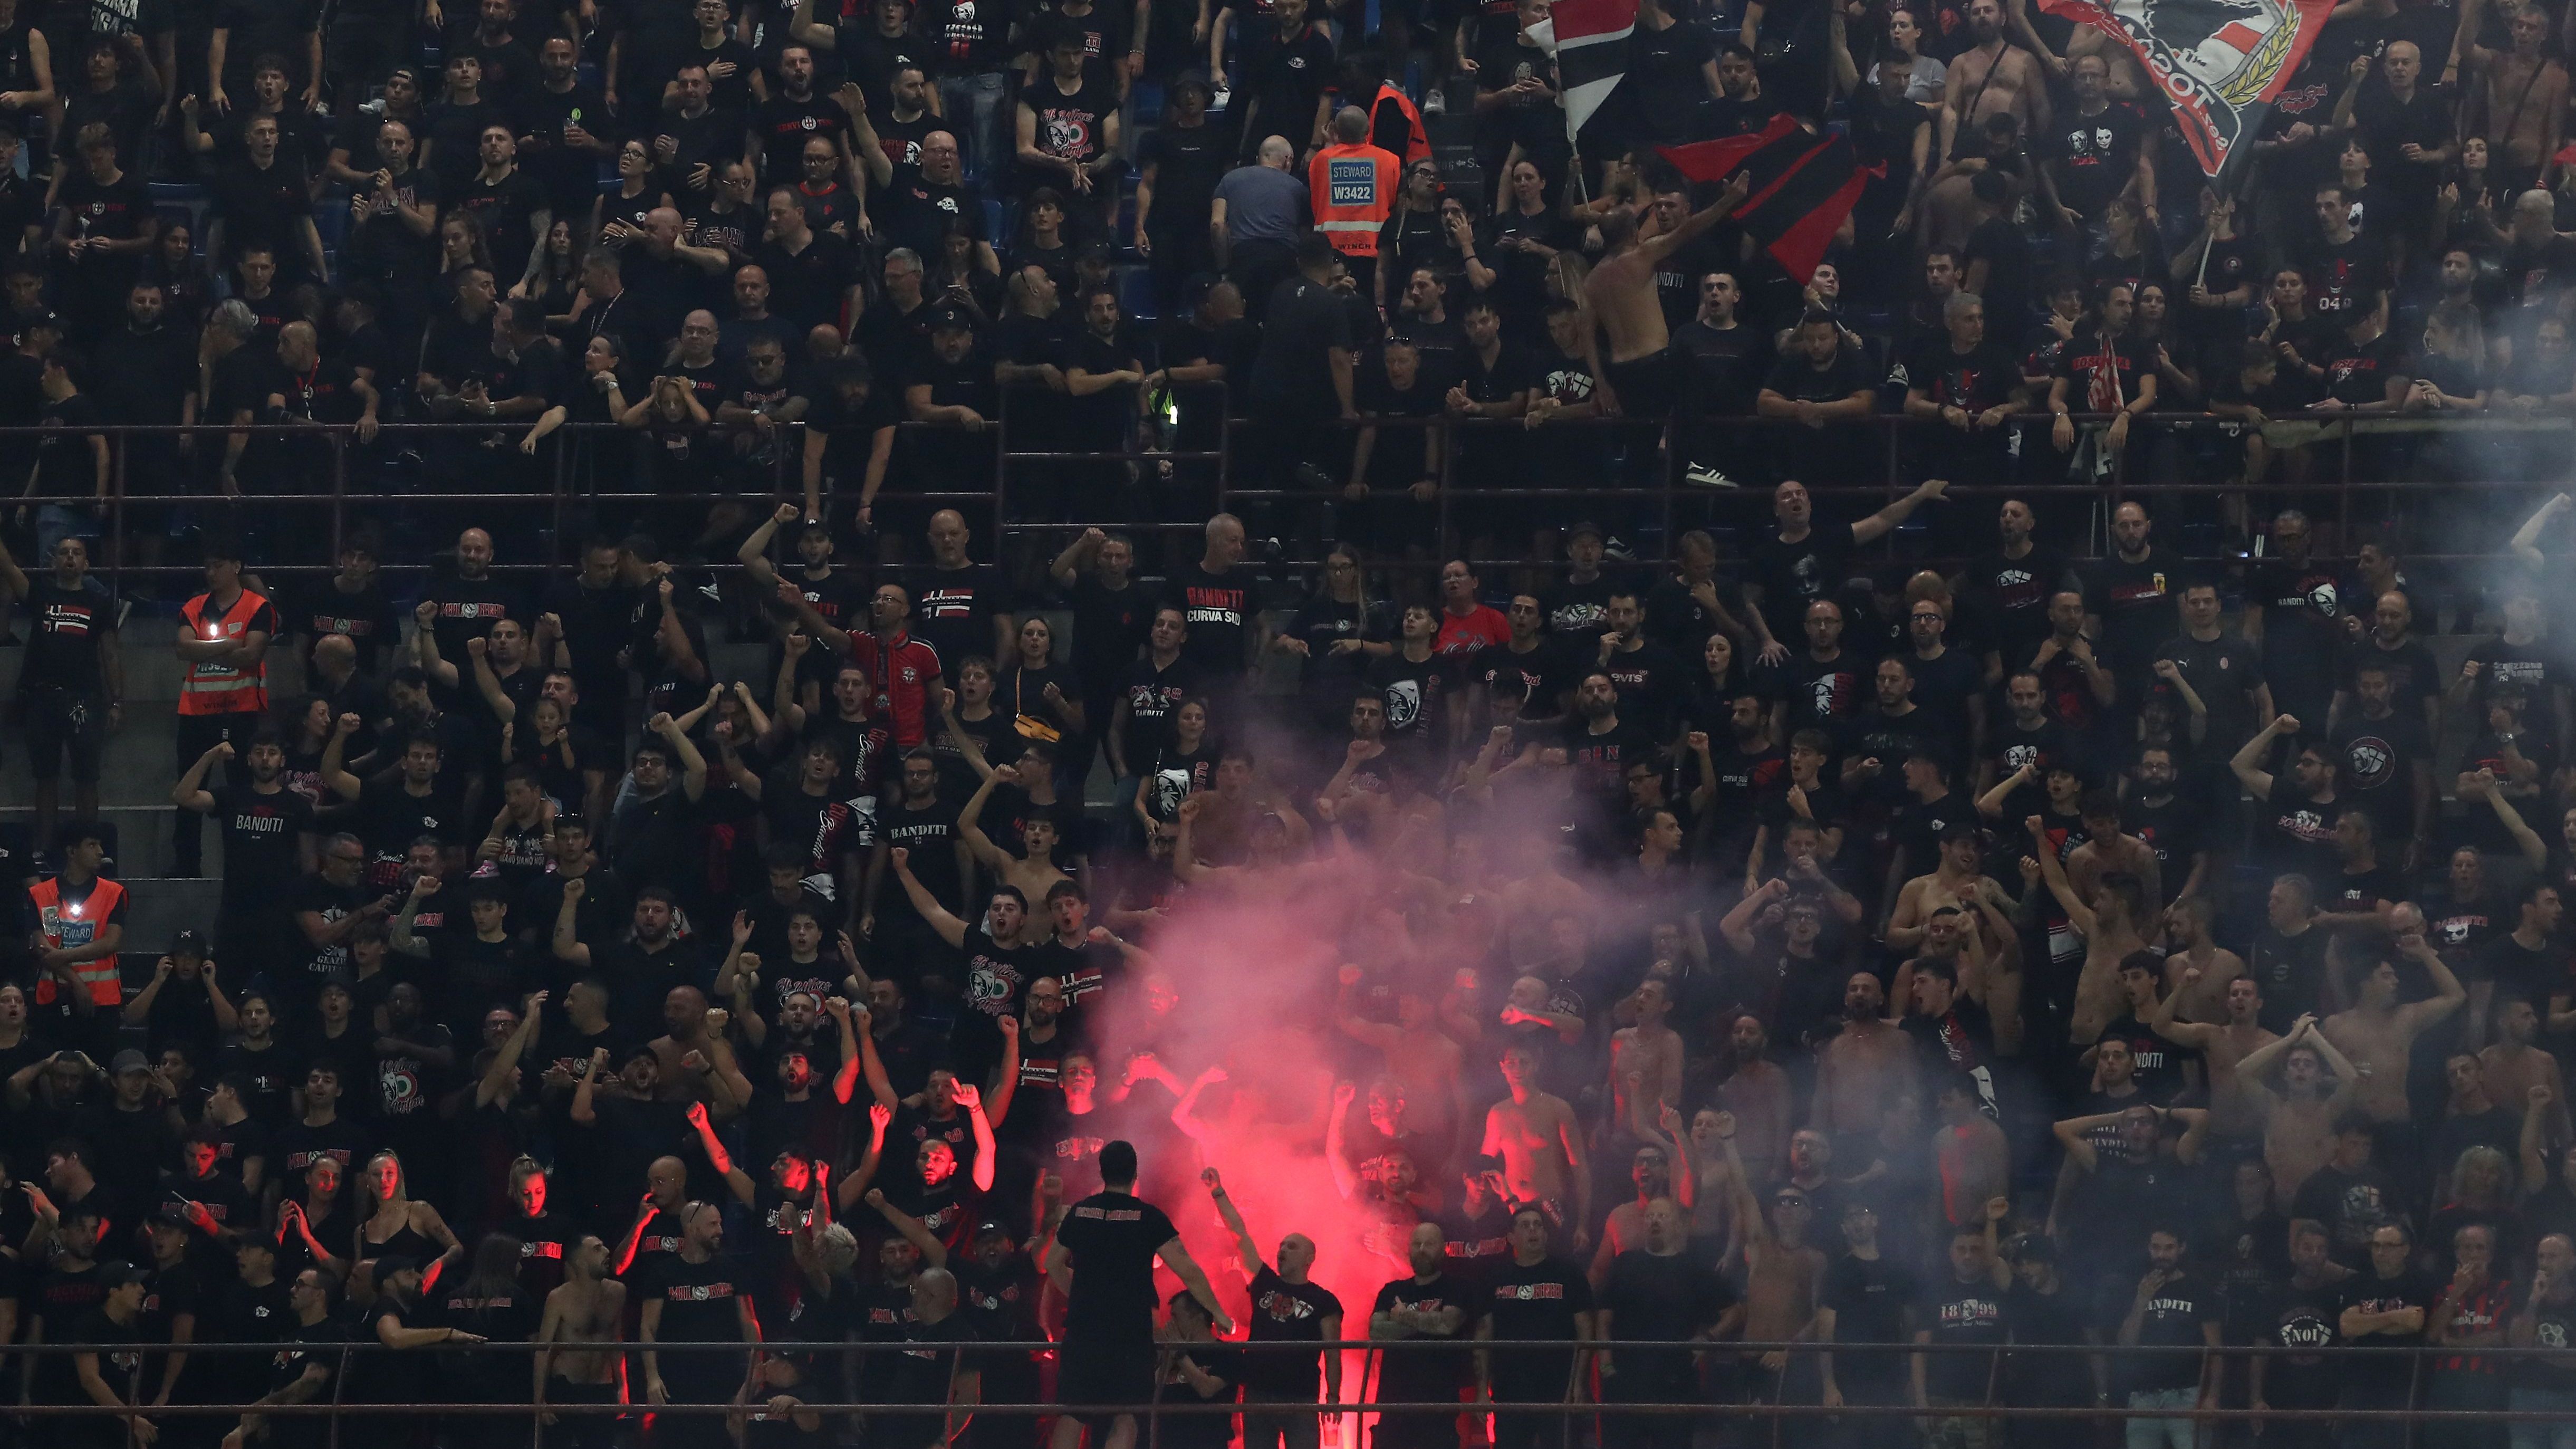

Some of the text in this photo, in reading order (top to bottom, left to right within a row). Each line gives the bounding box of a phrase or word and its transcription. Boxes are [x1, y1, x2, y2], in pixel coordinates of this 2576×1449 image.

[1332, 166, 1372, 180] STEWARD
[1333, 186, 1371, 200] W3422
[1655, 272, 1684, 288] NDITI
[1187, 587, 1245, 609] BANDITI
[1187, 610, 1241, 626] CURVA SUD
[1611, 673, 1643, 683] evi's
[236, 814, 284, 833] BANDITI
[891, 824, 948, 840] BANDITI
[61, 927, 91, 942] TEWARD
[2135, 1052, 2164, 1068] NDITI
[2145, 1299, 2193, 1313] ANDITI
[2293, 1328, 2319, 1343] NOI
